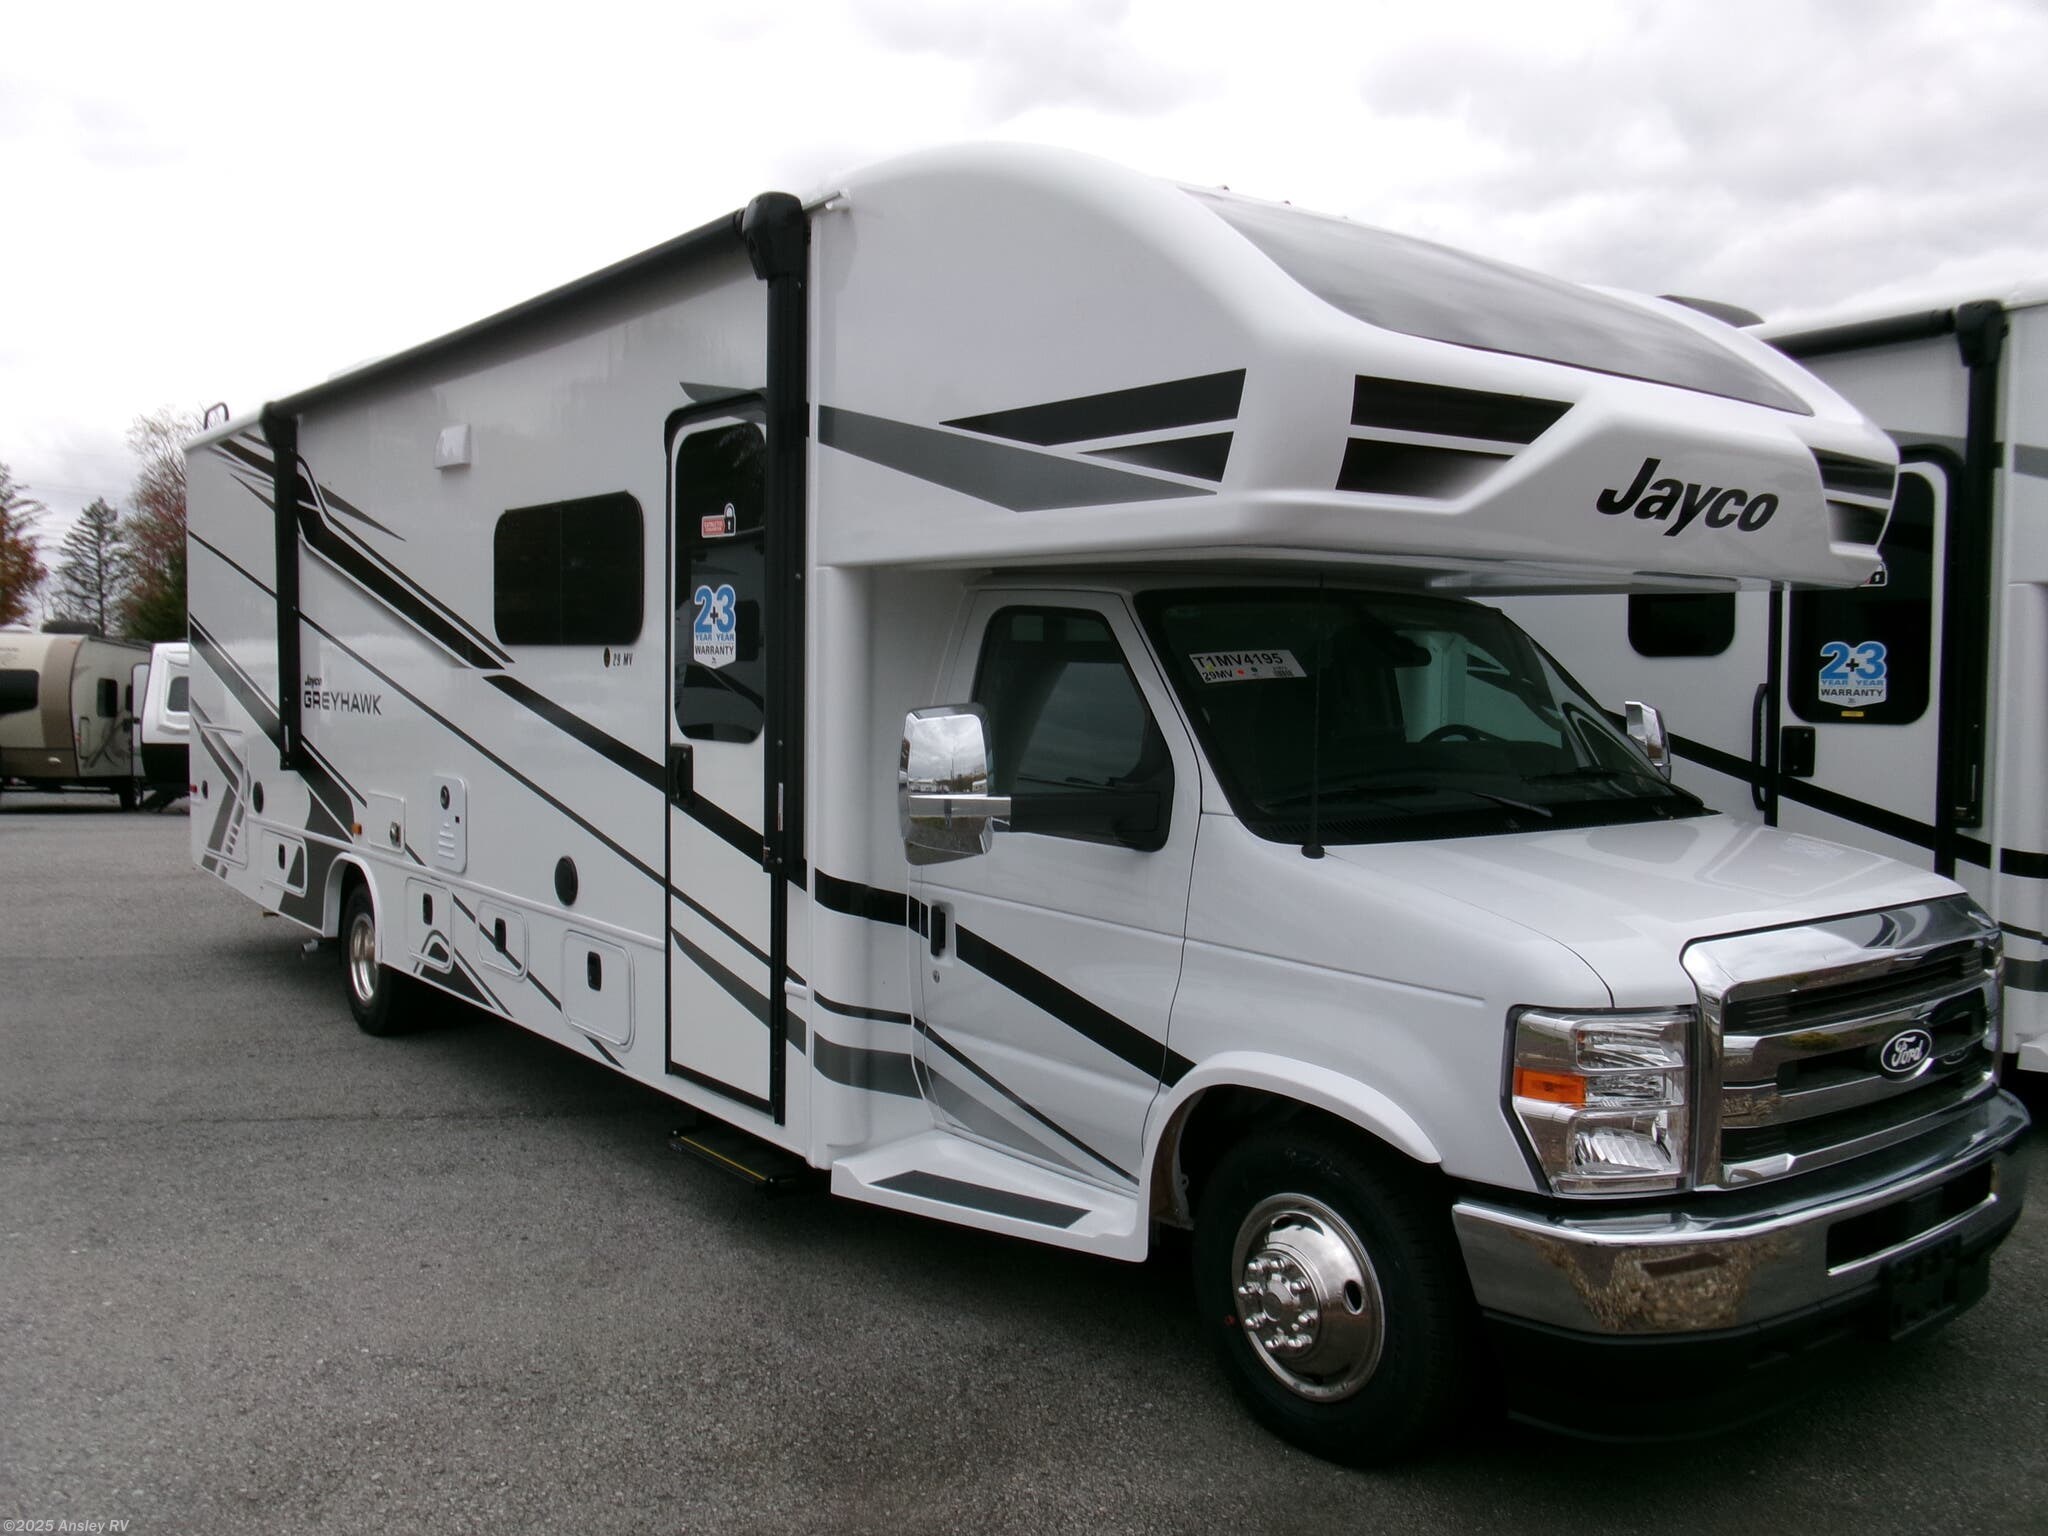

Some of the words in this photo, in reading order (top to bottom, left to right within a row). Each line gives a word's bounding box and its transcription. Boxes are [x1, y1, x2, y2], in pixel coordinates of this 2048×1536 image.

[1596, 457, 1779, 537] Jayco
[696, 633, 712, 641] YEAR
[716, 633, 735, 641] YEAR
[695, 645, 735, 656] WARRANTY
[1192, 653, 1284, 668] T1MV4195
[1201, 670, 1233, 682] 29MV
[1821, 688, 1884, 697] WARRANTY
[304, 691, 382, 716] GREYHAWK
[1891, 1036, 1924, 1067] Ford
